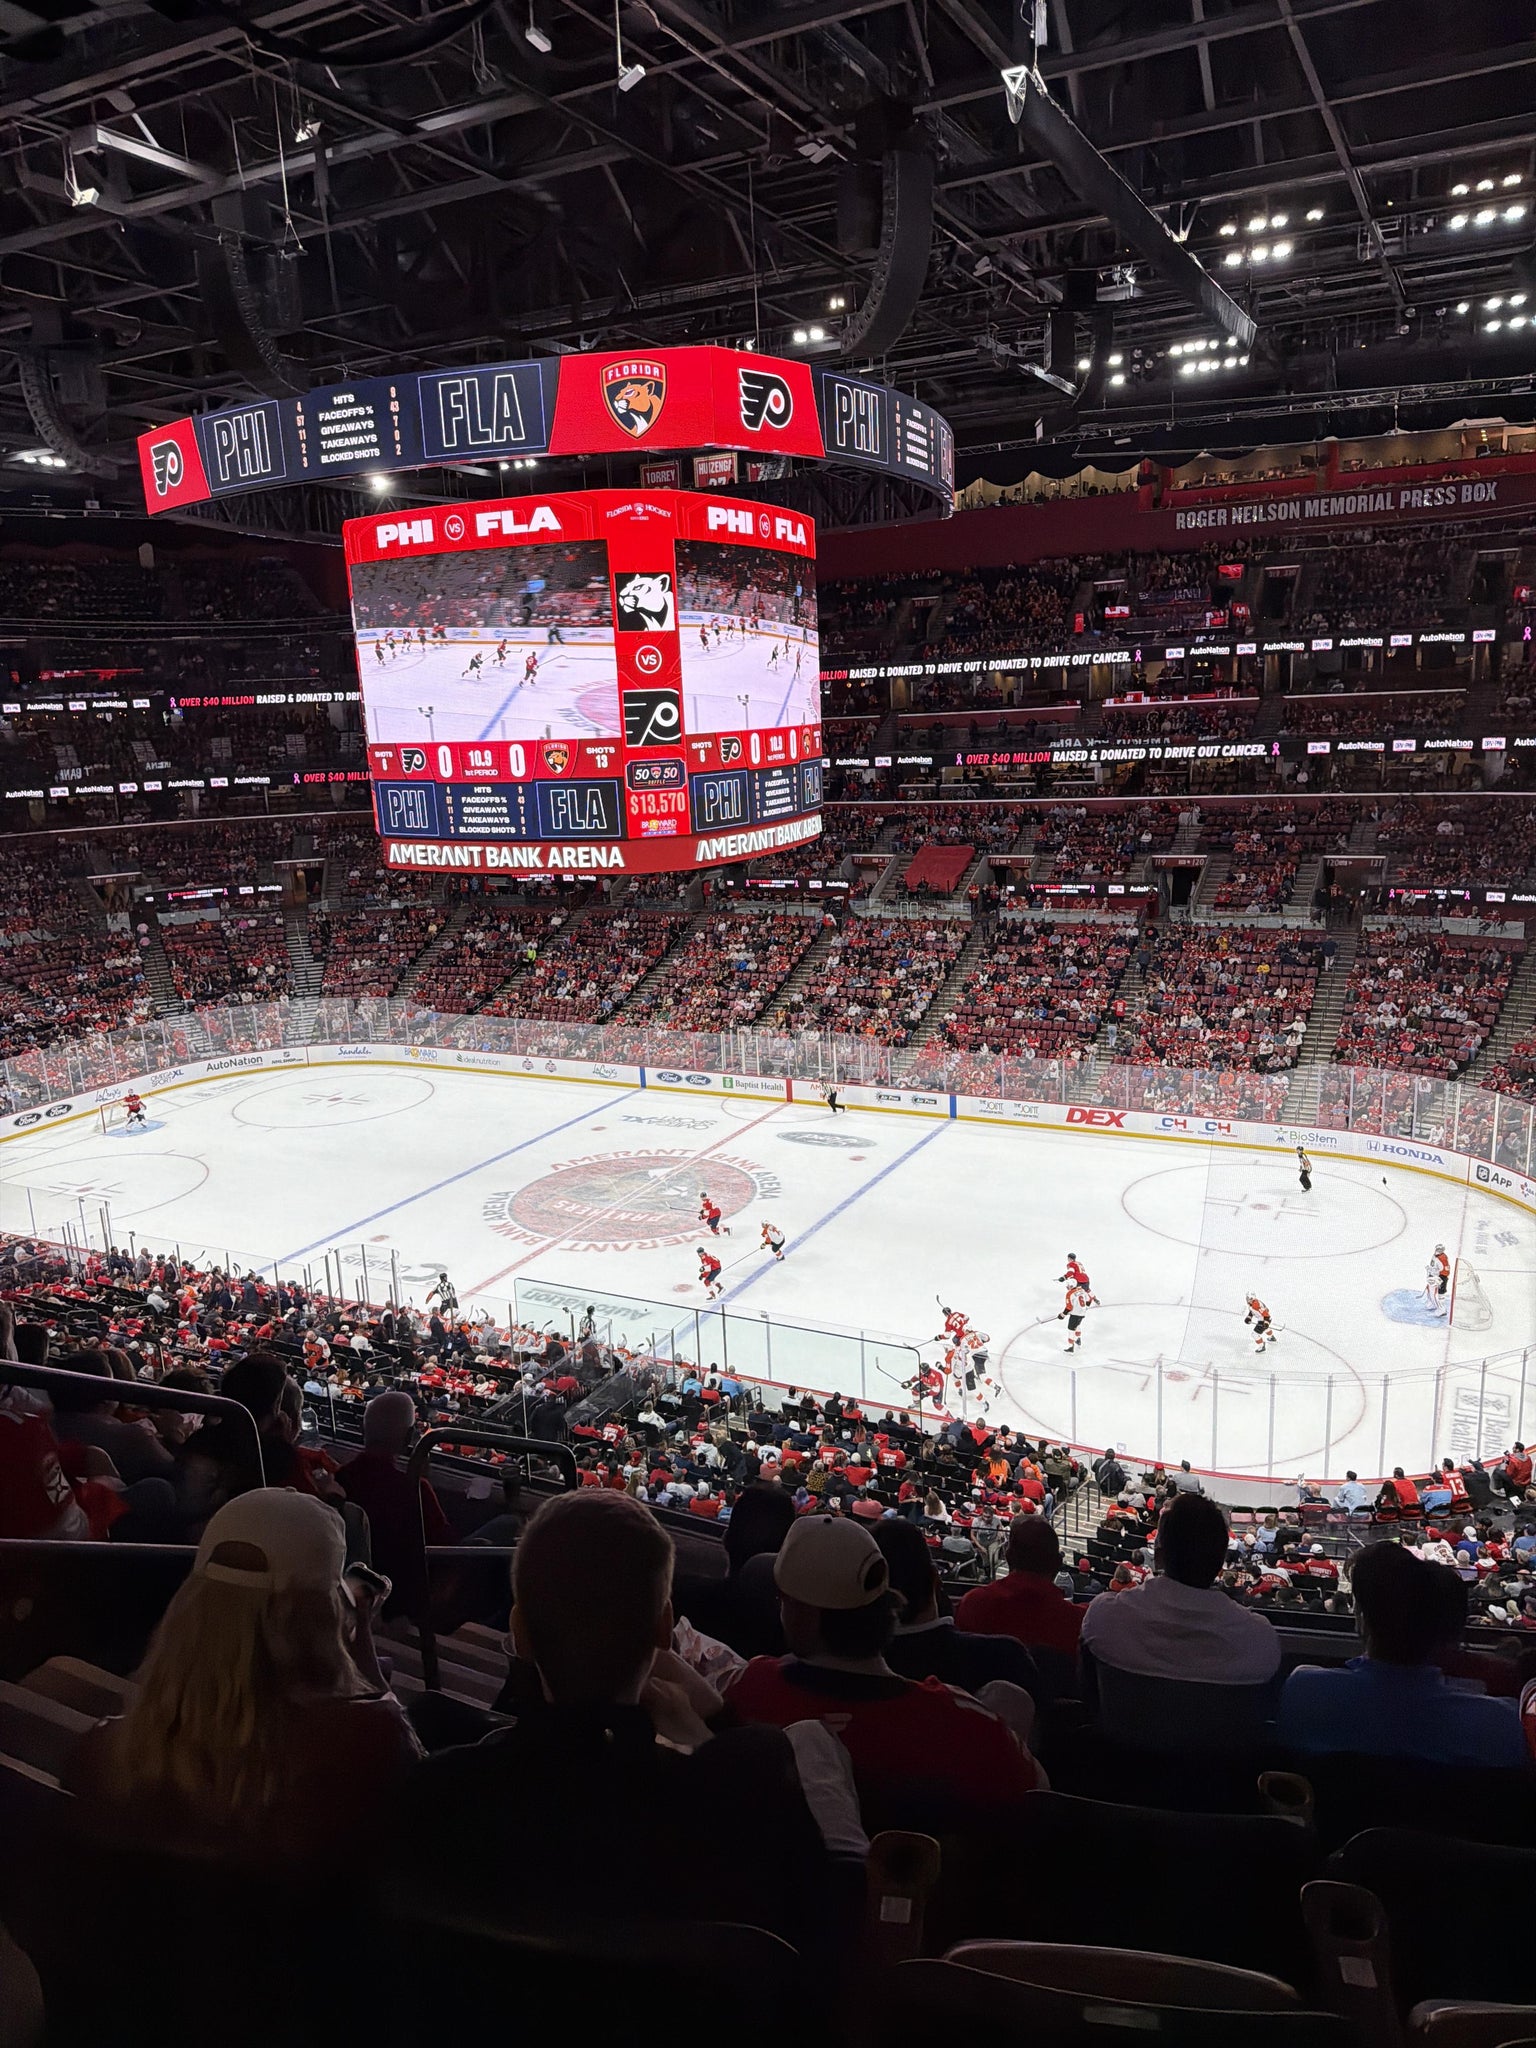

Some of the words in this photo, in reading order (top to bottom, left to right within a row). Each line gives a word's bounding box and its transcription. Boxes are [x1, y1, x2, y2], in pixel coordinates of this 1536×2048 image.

[607, 363, 661, 380] FLORIDA
[333, 394, 355, 405] HITS
[319, 406, 366, 422] FACEOFFS
[438, 373, 526, 448] FLA
[834, 383, 880, 454] PHI
[320, 420, 375, 436] GIVEAWAYS
[213, 410, 272, 481] PHI
[302, 443, 307, 454] 2
[320, 434, 378, 450] TAKEAWAYS
[321, 451, 355, 464] BLOCKED
[354, 448, 380, 460] SHOTS
[396, 444, 402, 456] 2
[606, 504, 632, 518] FLORIDA
[645, 504, 672, 518] HOCKEY
[1176, 510, 1228, 530] ROGER
[1232, 502, 1300, 526] NEILSON
[1304, 491, 1395, 518] MEMORIAL
[1400, 486, 1456, 509] PRESS
[1461, 481, 1498, 504] BOX
[376, 518, 434, 549] PHI
[448, 522, 462, 534] VS
[476, 506, 562, 538] FLA
[708, 506, 754, 535] PHI
[760, 520, 770, 532] VS
[775, 518, 806, 546] FLA
[1340, 637, 1383, 648] AutoNation
[1419, 632, 1465, 644] AutoNation
[1190, 646, 1230, 655] AutoNation
[1263, 641, 1304, 652] AutoNation
[640, 652, 658, 666] VS
[849, 668, 878, 679] RAISED
[878, 667, 886, 677] &
[886, 664, 924, 677] DONATED
[925, 664, 936, 674] TO
[938, 662, 962, 674] DRIVE
[964, 660, 982, 672] OUT
[988, 660, 1028, 670] DONATED
[1030, 658, 1041, 668] TO
[1044, 655, 1070, 667] DRIVE
[1072, 654, 1092, 665] OUT
[1092, 652, 1131, 664] CANCER.
[27, 702, 64, 712] AutoNation
[92, 700, 128, 708] AutoNation
[180, 698, 201, 707] OVER
[203, 696, 220, 706] $40
[221, 696, 255, 706] MILLION
[256, 694, 286, 704] RAISED
[288, 694, 294, 703] &
[296, 692, 332, 703] DONATED
[334, 692, 344, 701] TO
[586, 746, 616, 754] SHOTS
[691, 741, 712, 749] SHOTS
[750, 732, 760, 764] 0
[790, 728, 798, 760] 0
[1338, 740, 1385, 750] AutoNation
[1424, 738, 1474, 750] AutoNation
[438, 745, 453, 778] 0
[468, 750, 493, 767] 10.9
[509, 744, 526, 778] 0
[596, 754, 608, 768] 13
[897, 754, 932, 764] AutoNation
[966, 754, 990, 765] OVER
[992, 752, 1010, 765] $40
[1012, 751, 1051, 764] MILLION
[1052, 750, 1088, 762] RAISED
[1090, 750, 1098, 760] &
[1100, 748, 1146, 760] DONATED
[1149, 747, 1162, 758] TO
[1164, 746, 1197, 758] DRIVE
[1198, 746, 1221, 758] OUT
[1222, 744, 1268, 757] CANCER.
[836, 758, 869, 767] AutoNation
[234, 775, 270, 785] AutoNation
[303, 773, 326, 782] OVER
[328, 772, 346, 782] $40
[634, 768, 650, 780] 50
[663, 766, 678, 778] 50
[75, 785, 114, 794] AutoNation
[168, 778, 204, 788] AutoNation
[5, 789, 44, 798] AutoNation
[704, 778, 742, 822] PHI
[388, 790, 429, 829] PHI
[550, 789, 608, 830] FLA
[630, 792, 686, 816] $13,570
[696, 828, 776, 862] AMERANT
[776, 822, 803, 846] BANK
[802, 814, 822, 840] ARENA
[389, 843, 484, 867] AMERANT
[486, 845, 544, 868] BANK
[548, 846, 625, 868] ARENA
[206, 1056, 263, 1072] AutoNation
[660, 1072, 680, 1082] Ford
[689, 1074, 708, 1085] Ford
[734, 1080, 759, 1092] Baptist
[760, 1081, 784, 1092] Health
[50, 1104, 71, 1117] Ford
[1066, 1107, 1128, 1128] DEX
[20, 1114, 40, 1126] Ford
[1162, 1117, 1187, 1129] CH
[1204, 1121, 1231, 1133] CH
[1290, 1130, 1338, 1144] BioStem
[1382, 1143, 1445, 1165] HONDA
[550, 1148, 698, 1172] AMERANT
[708, 1152, 766, 1172] BANK
[752, 1171, 783, 1200] ARENA
[482, 1190, 516, 1223] ARENA
[488, 1216, 548, 1246] BANK
[1078, 1296, 1086, 1308] 6
[1449, 1478, 1467, 1496] 13
